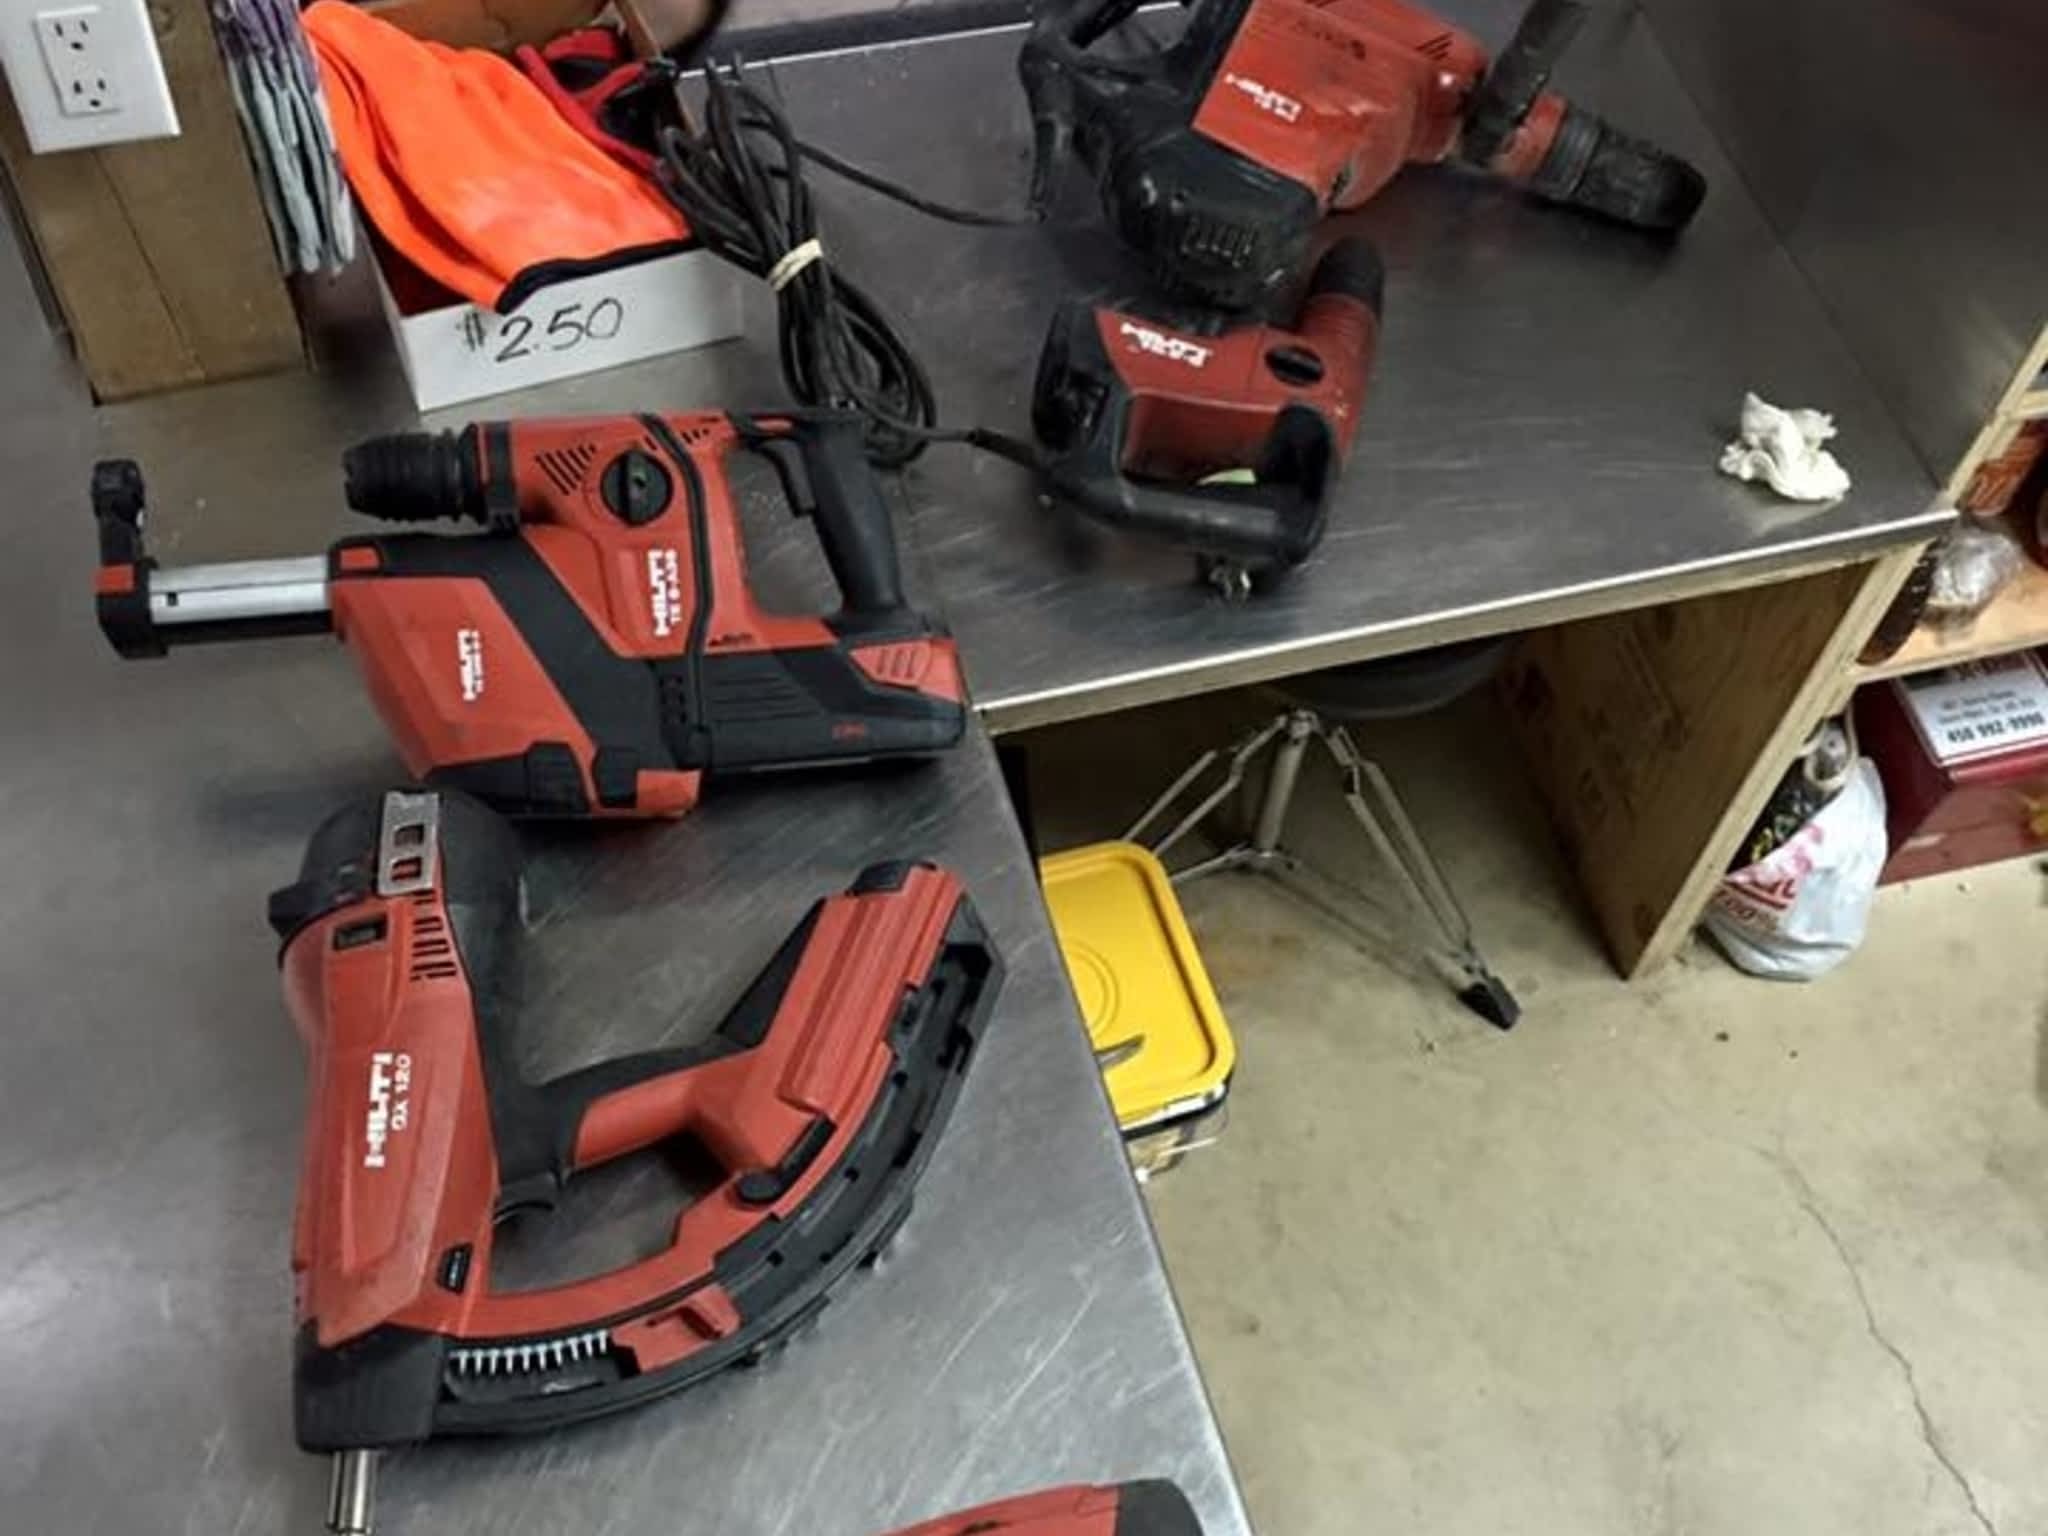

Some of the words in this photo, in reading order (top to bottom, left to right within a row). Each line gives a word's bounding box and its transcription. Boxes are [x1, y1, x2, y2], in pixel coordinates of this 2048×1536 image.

[455, 297, 623, 362] $2.50
[647, 549, 670, 635] HILTI
[457, 629, 476, 700] HILTI
[394, 1053, 411, 1093] 120
[364, 1051, 393, 1168] HILTI
